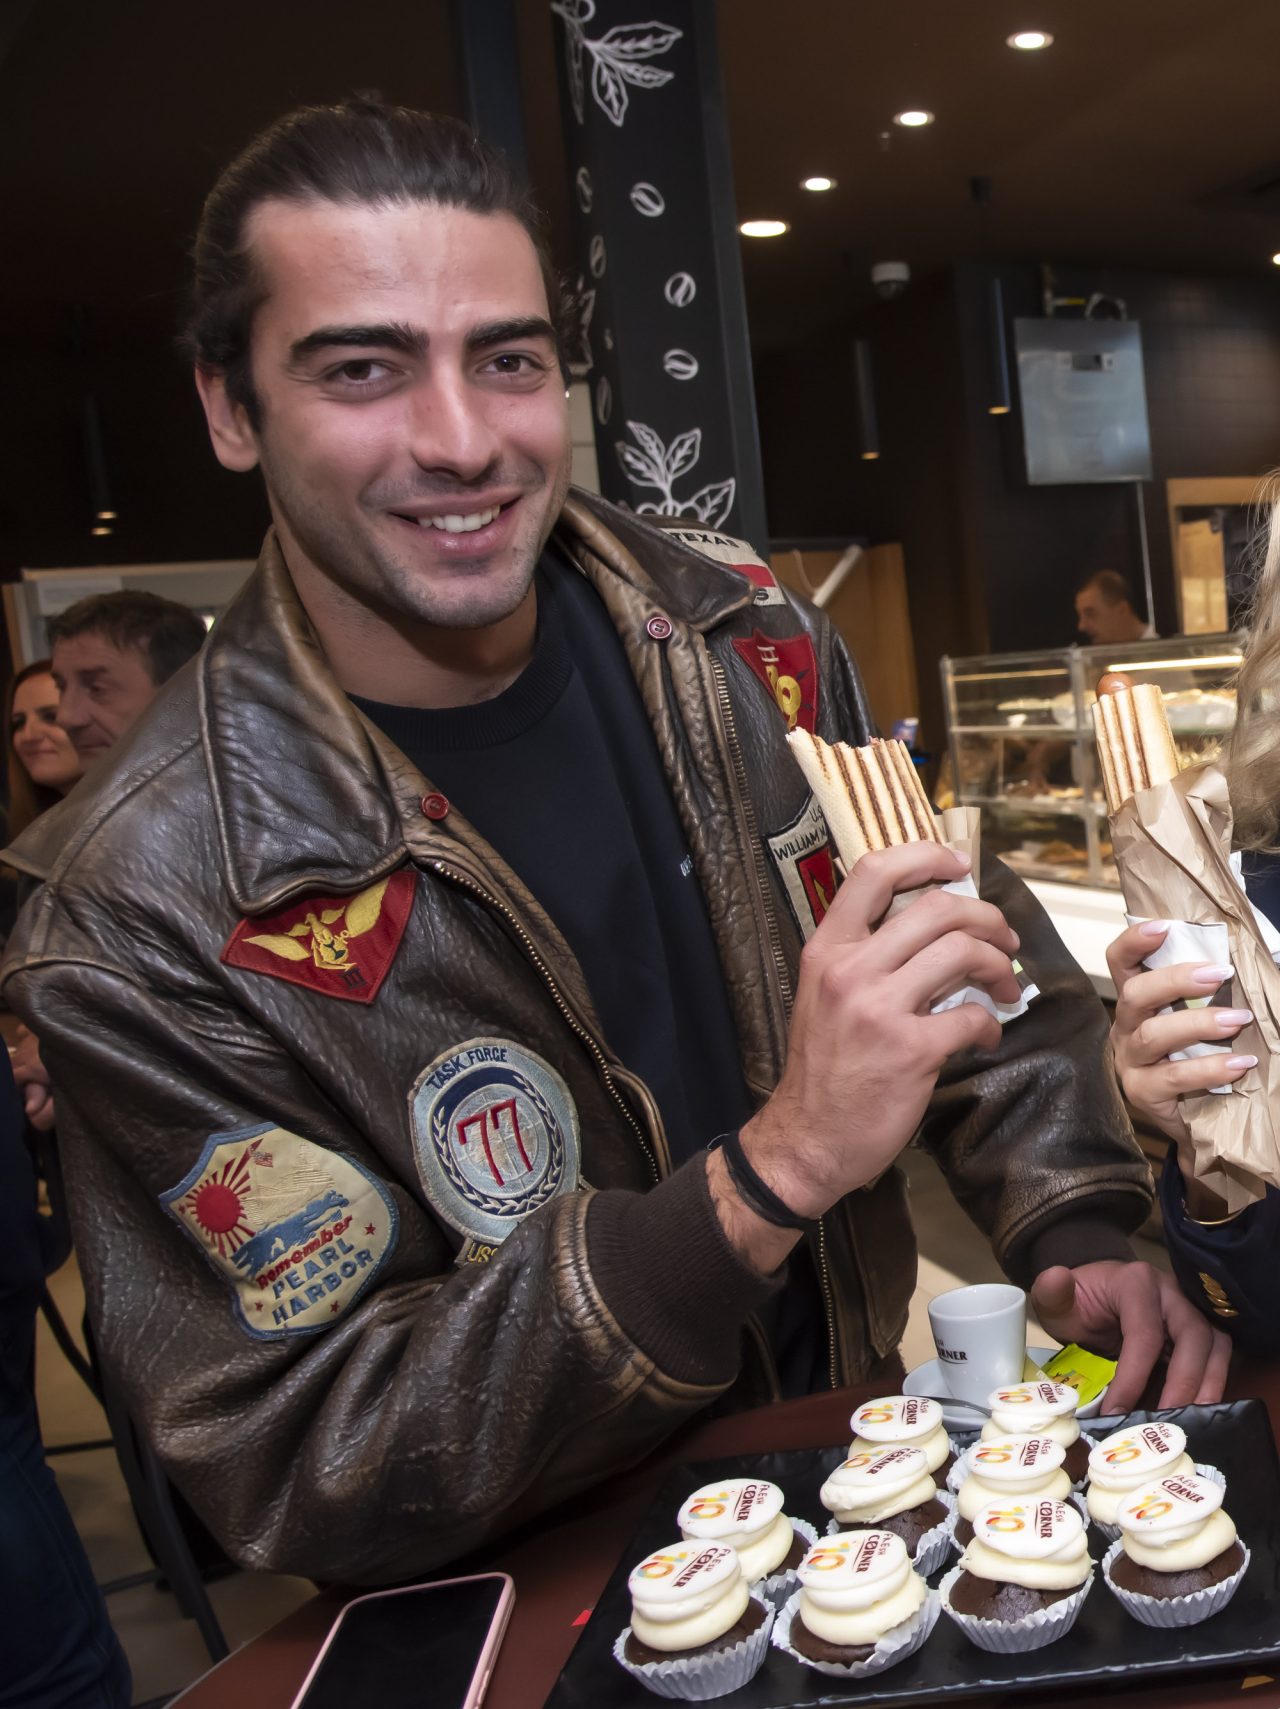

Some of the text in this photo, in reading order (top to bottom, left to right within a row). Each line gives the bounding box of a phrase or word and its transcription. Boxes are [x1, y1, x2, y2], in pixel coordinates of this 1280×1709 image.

[773, 829, 821, 861] WILLIAM
[426, 1047, 508, 1089] TASK FORCE
[456, 1097, 534, 1187] 77
[272, 1238, 354, 1299] PEARL
[272, 1248, 373, 1326] HARBOR
